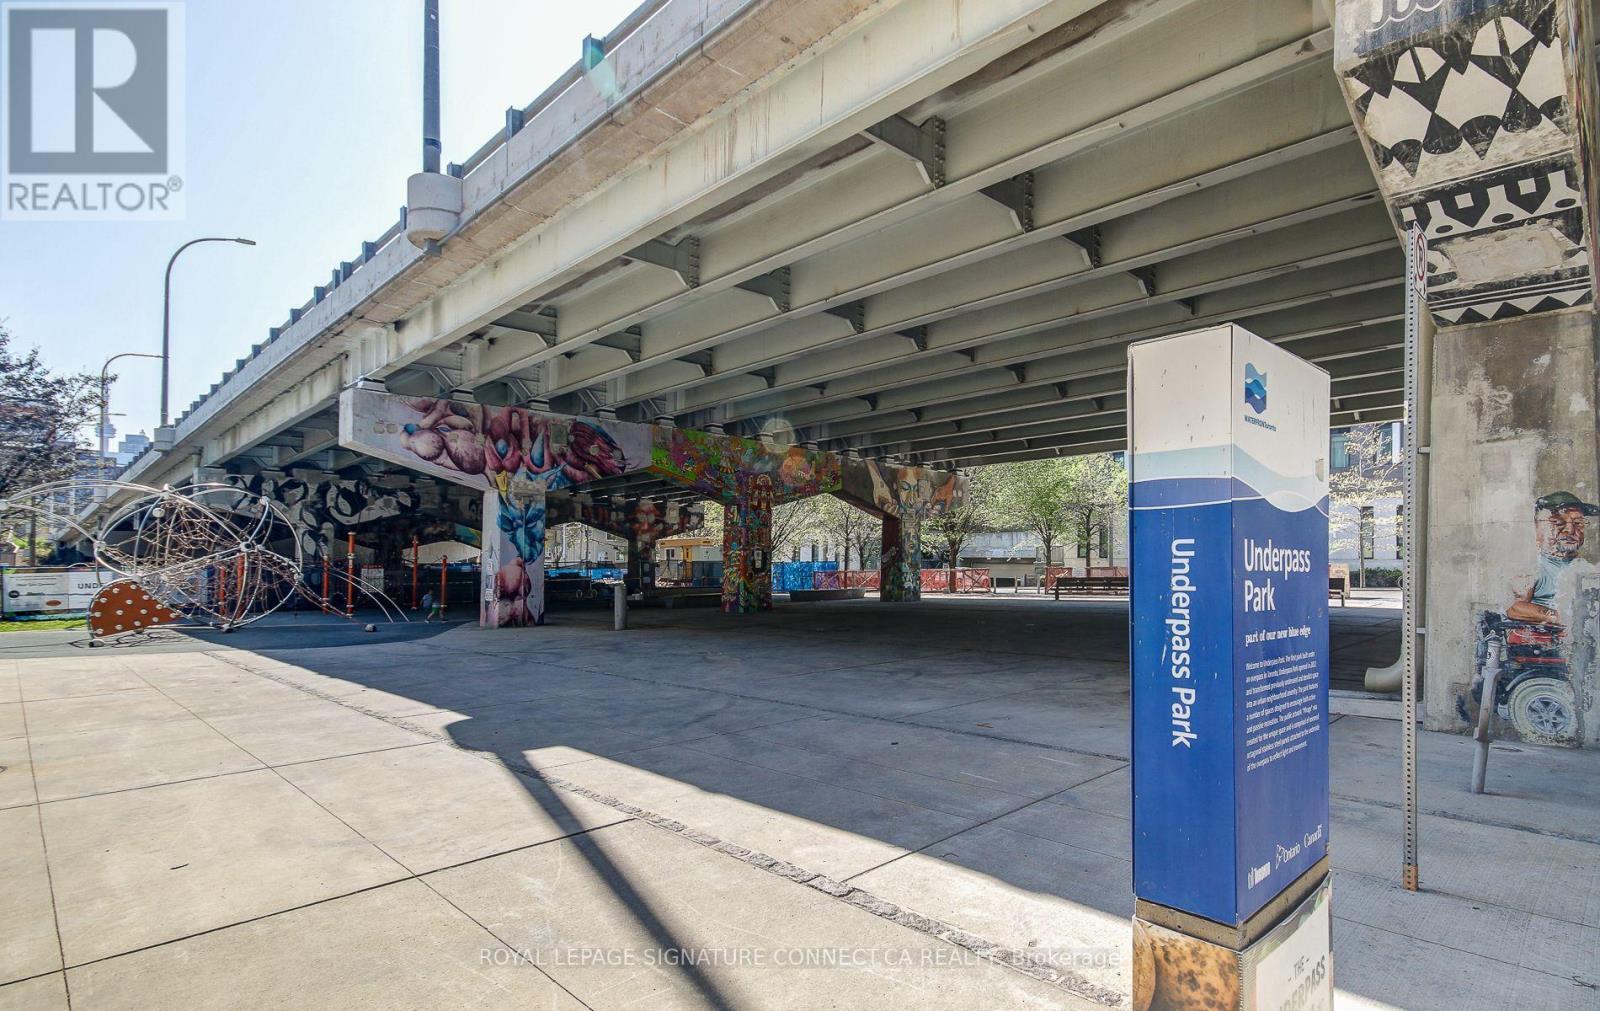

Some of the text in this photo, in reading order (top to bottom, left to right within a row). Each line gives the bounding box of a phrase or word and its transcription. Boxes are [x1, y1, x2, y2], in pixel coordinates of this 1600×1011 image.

[1244, 538, 1311, 580] Underpass
[77, 582, 105, 590] UND
[1244, 578, 1276, 612] Park
[1165, 538, 1198, 749] Underpass Park
[1245, 625, 1311, 647] part of our new blue edge
[1283, 842, 1301, 863] Ontario
[1303, 824, 1323, 848] Canada
